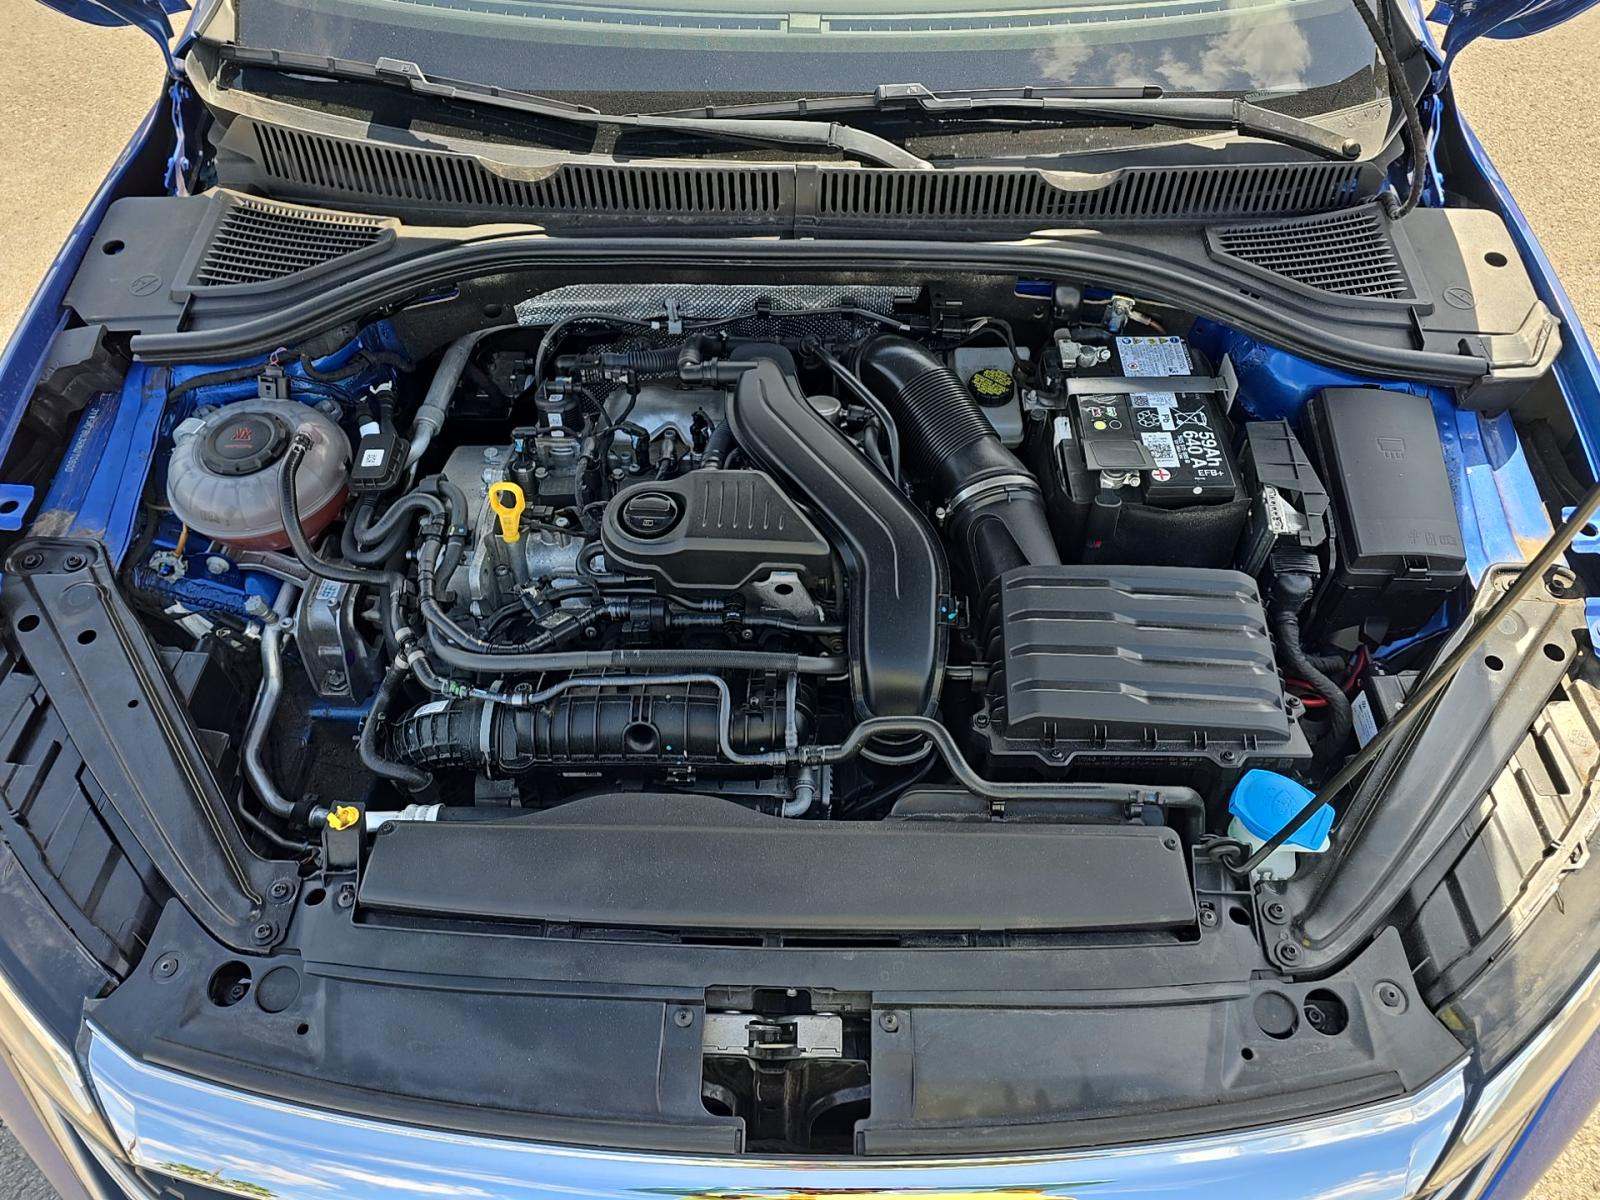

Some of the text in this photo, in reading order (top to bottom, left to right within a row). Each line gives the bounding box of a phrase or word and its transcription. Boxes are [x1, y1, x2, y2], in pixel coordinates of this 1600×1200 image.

[1162, 414, 1170, 423] Pb
[1182, 430, 1204, 455] 640
[1199, 431, 1222, 466] 59Ah
[1190, 457, 1208, 469] A
[1197, 469, 1225, 477] EFB+
